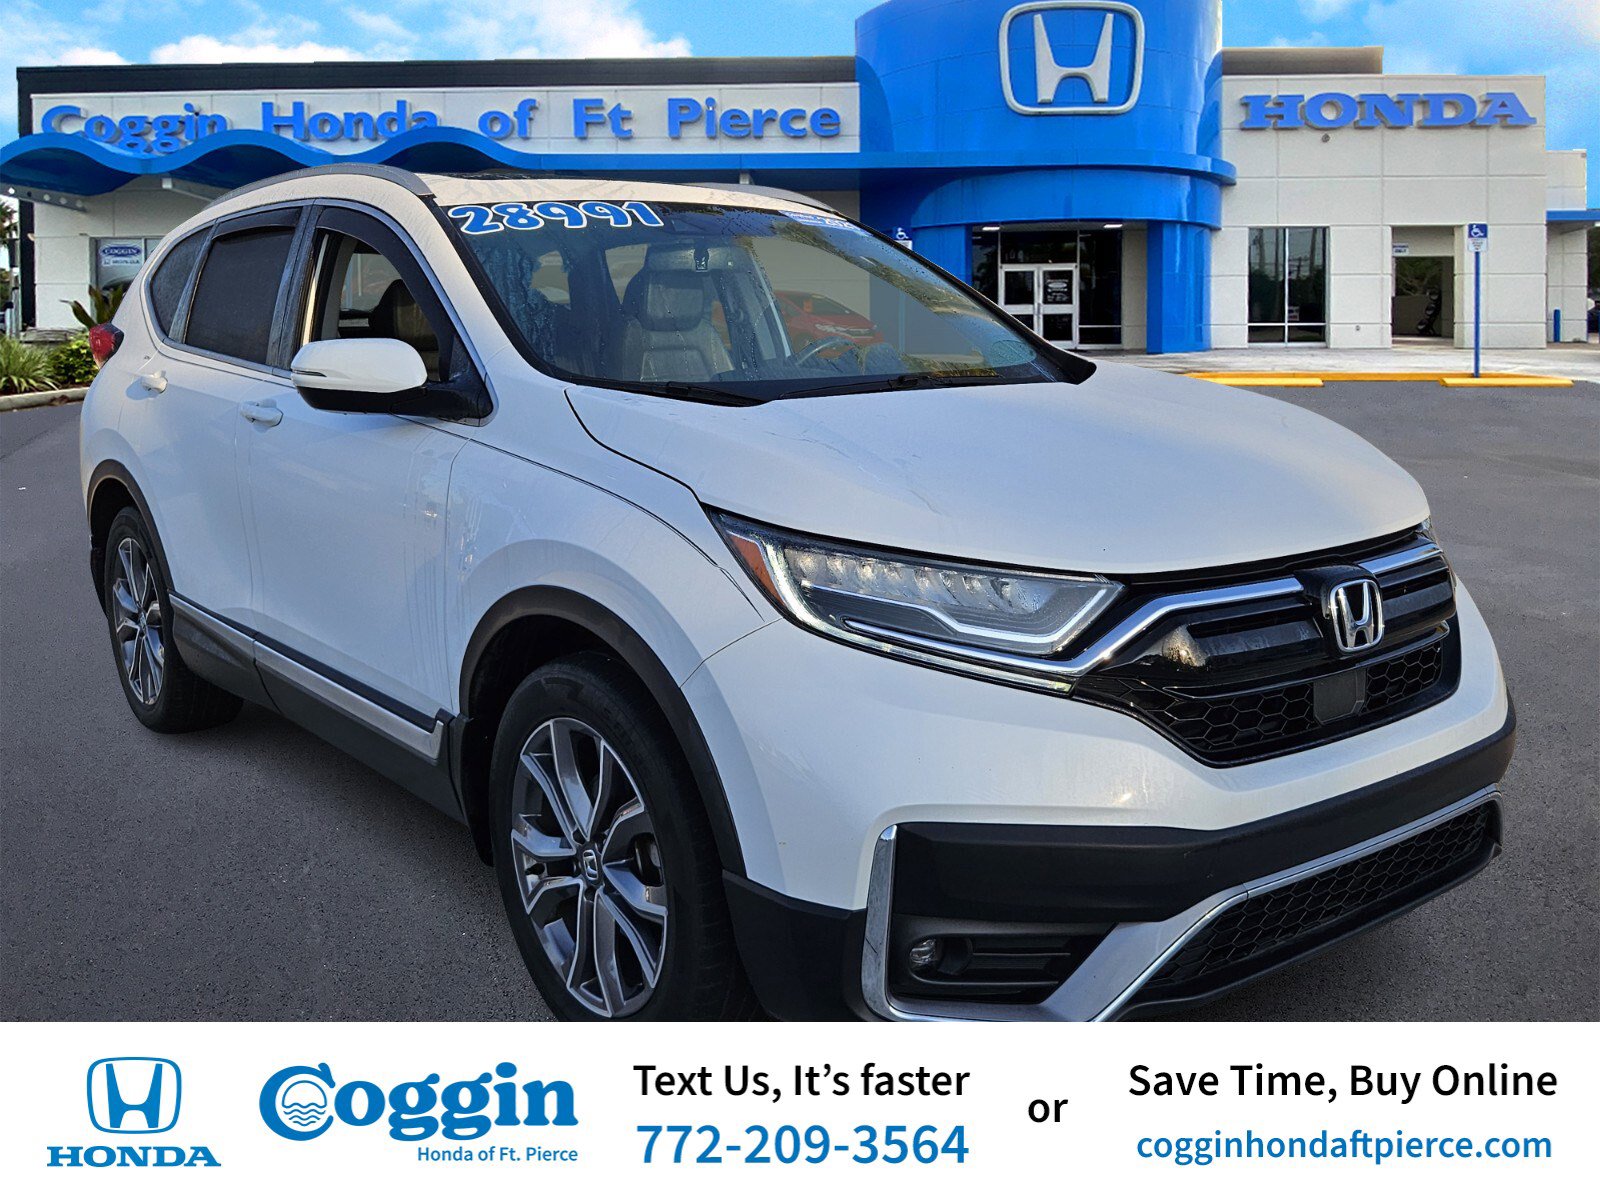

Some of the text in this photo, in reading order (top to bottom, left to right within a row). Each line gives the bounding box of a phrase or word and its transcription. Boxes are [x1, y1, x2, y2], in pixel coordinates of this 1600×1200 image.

[41, 97, 842, 154] Coggin Honda of Ft Pierce
[1240, 92, 1537, 130] HONDA
[447, 202, 664, 236] 28991
